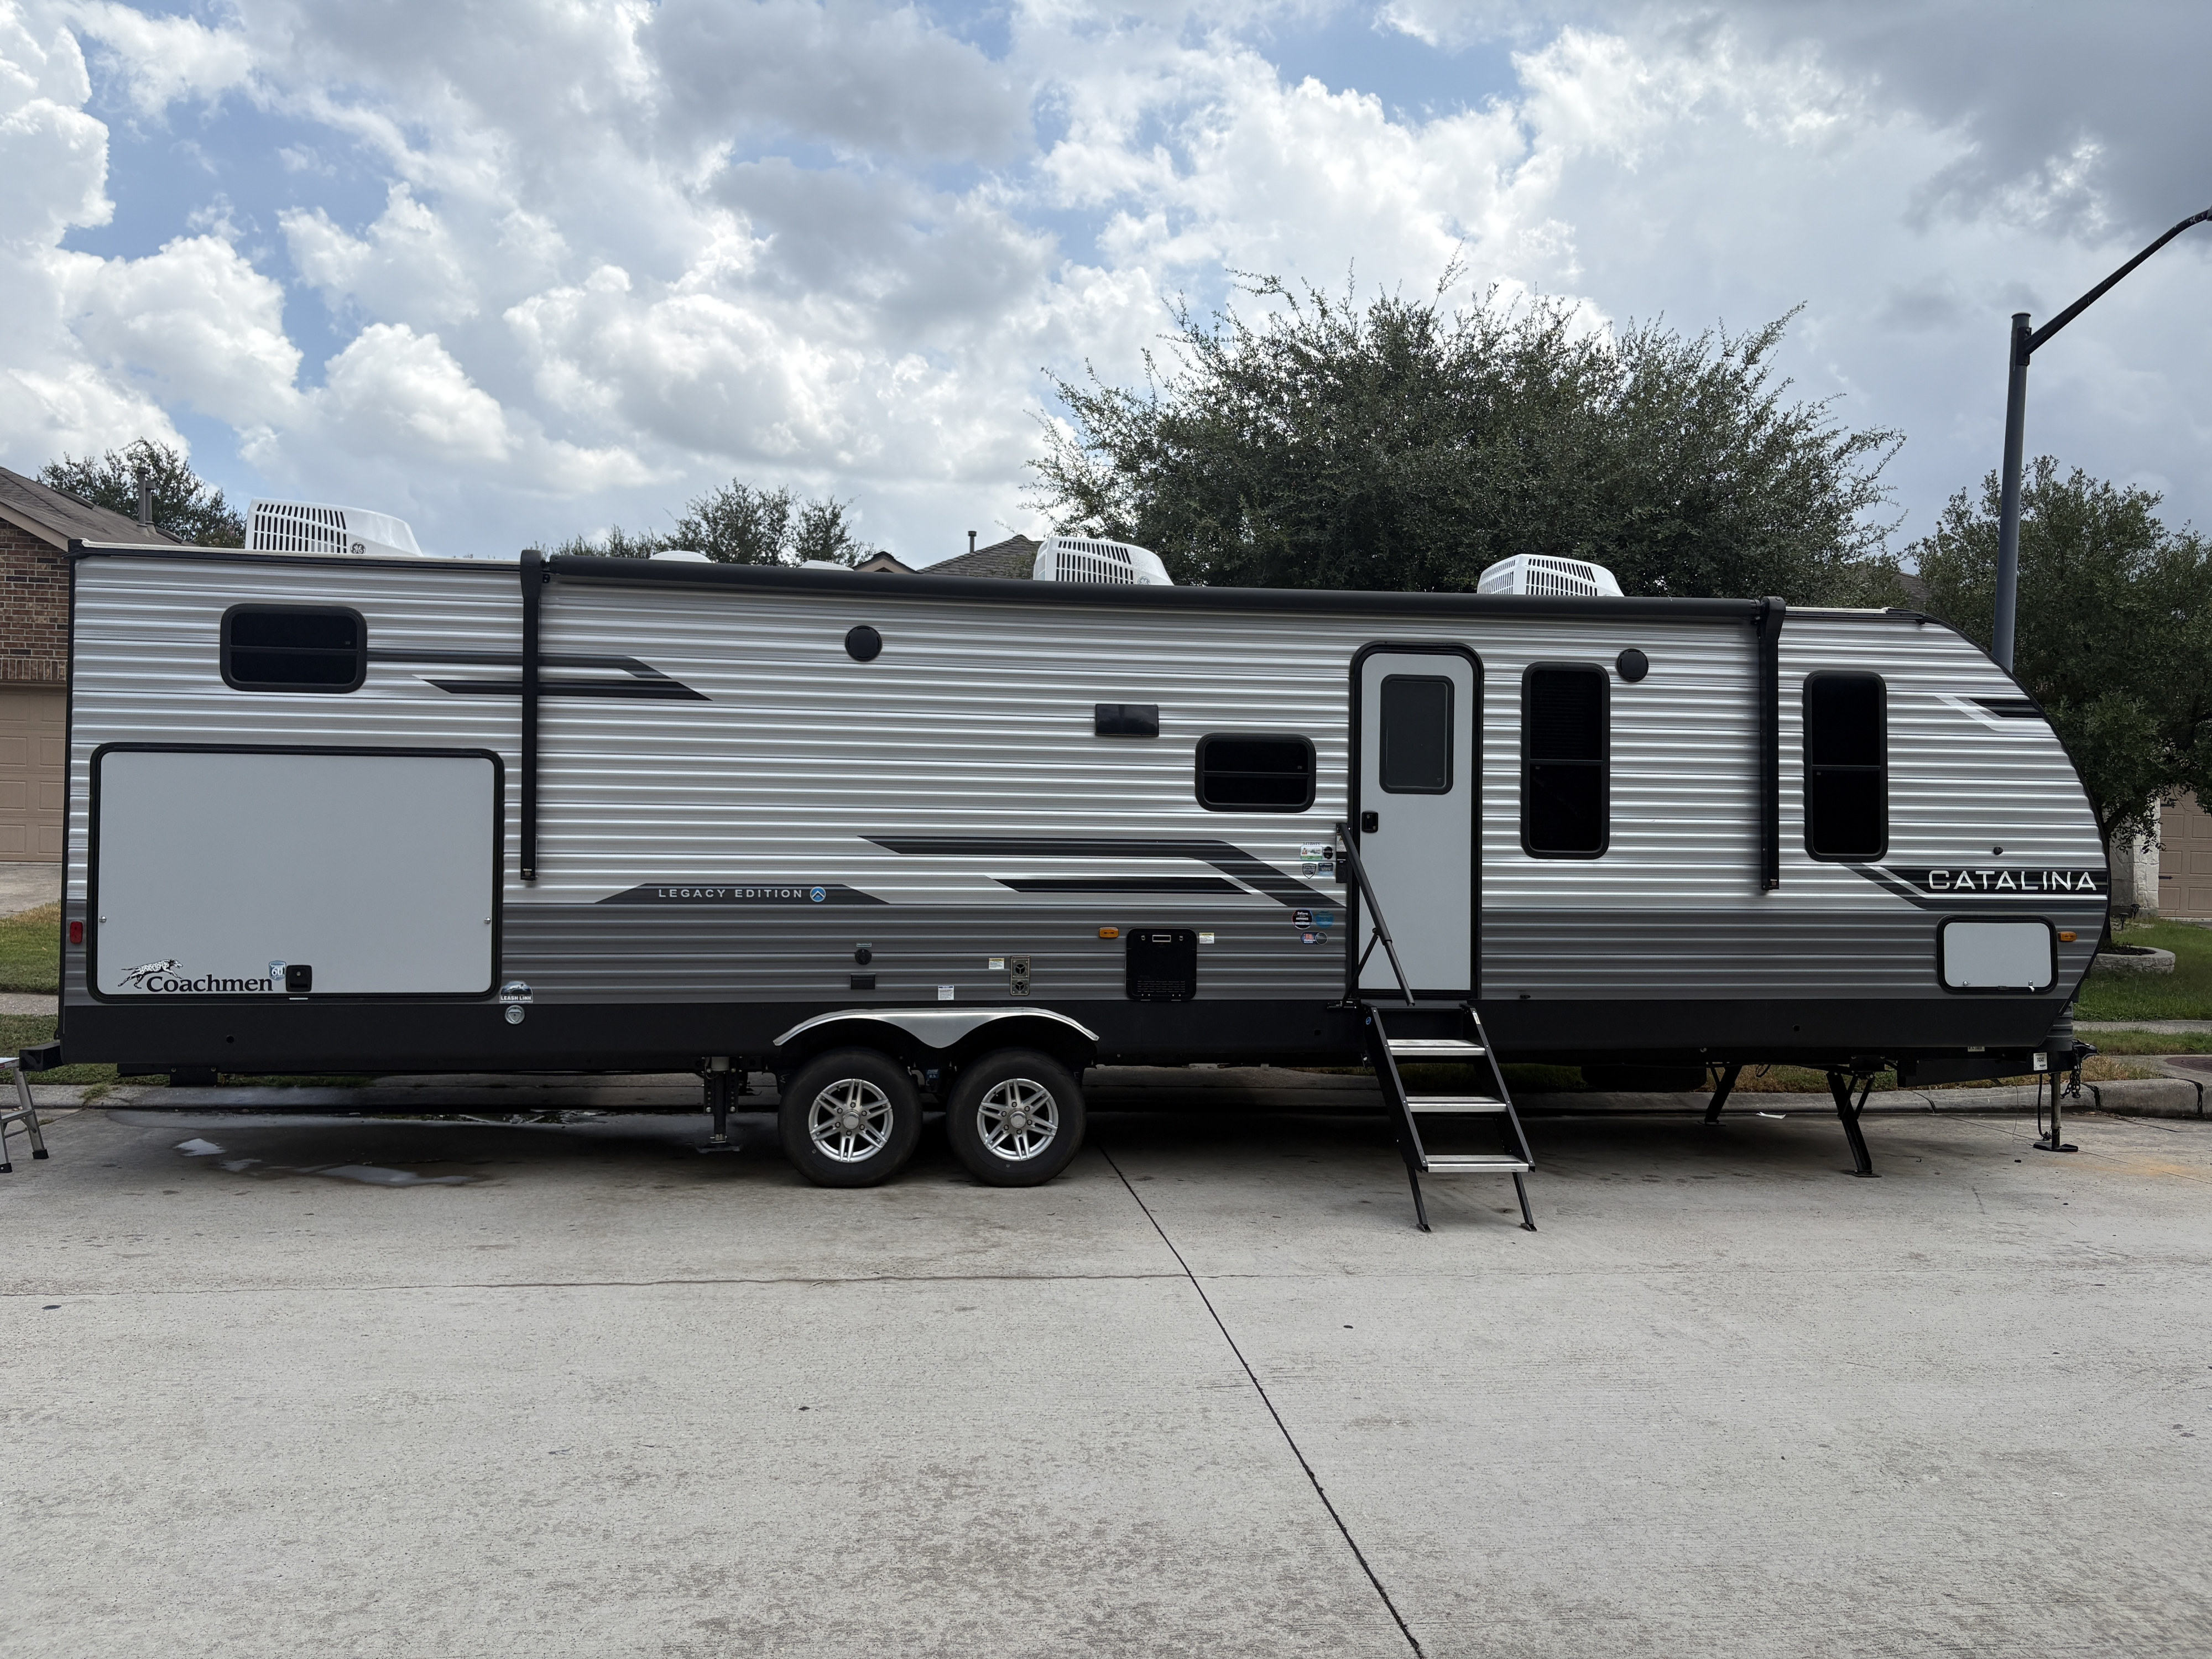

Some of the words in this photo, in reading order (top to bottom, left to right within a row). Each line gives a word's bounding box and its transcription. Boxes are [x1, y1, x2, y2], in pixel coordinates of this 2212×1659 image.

[1928, 870, 2097, 891] CATALINA
[659, 889, 726, 898] LEGACY
[735, 889, 802, 898] EDITION
[272, 967, 283, 975] 60
[146, 974, 273, 993] Coachmen
